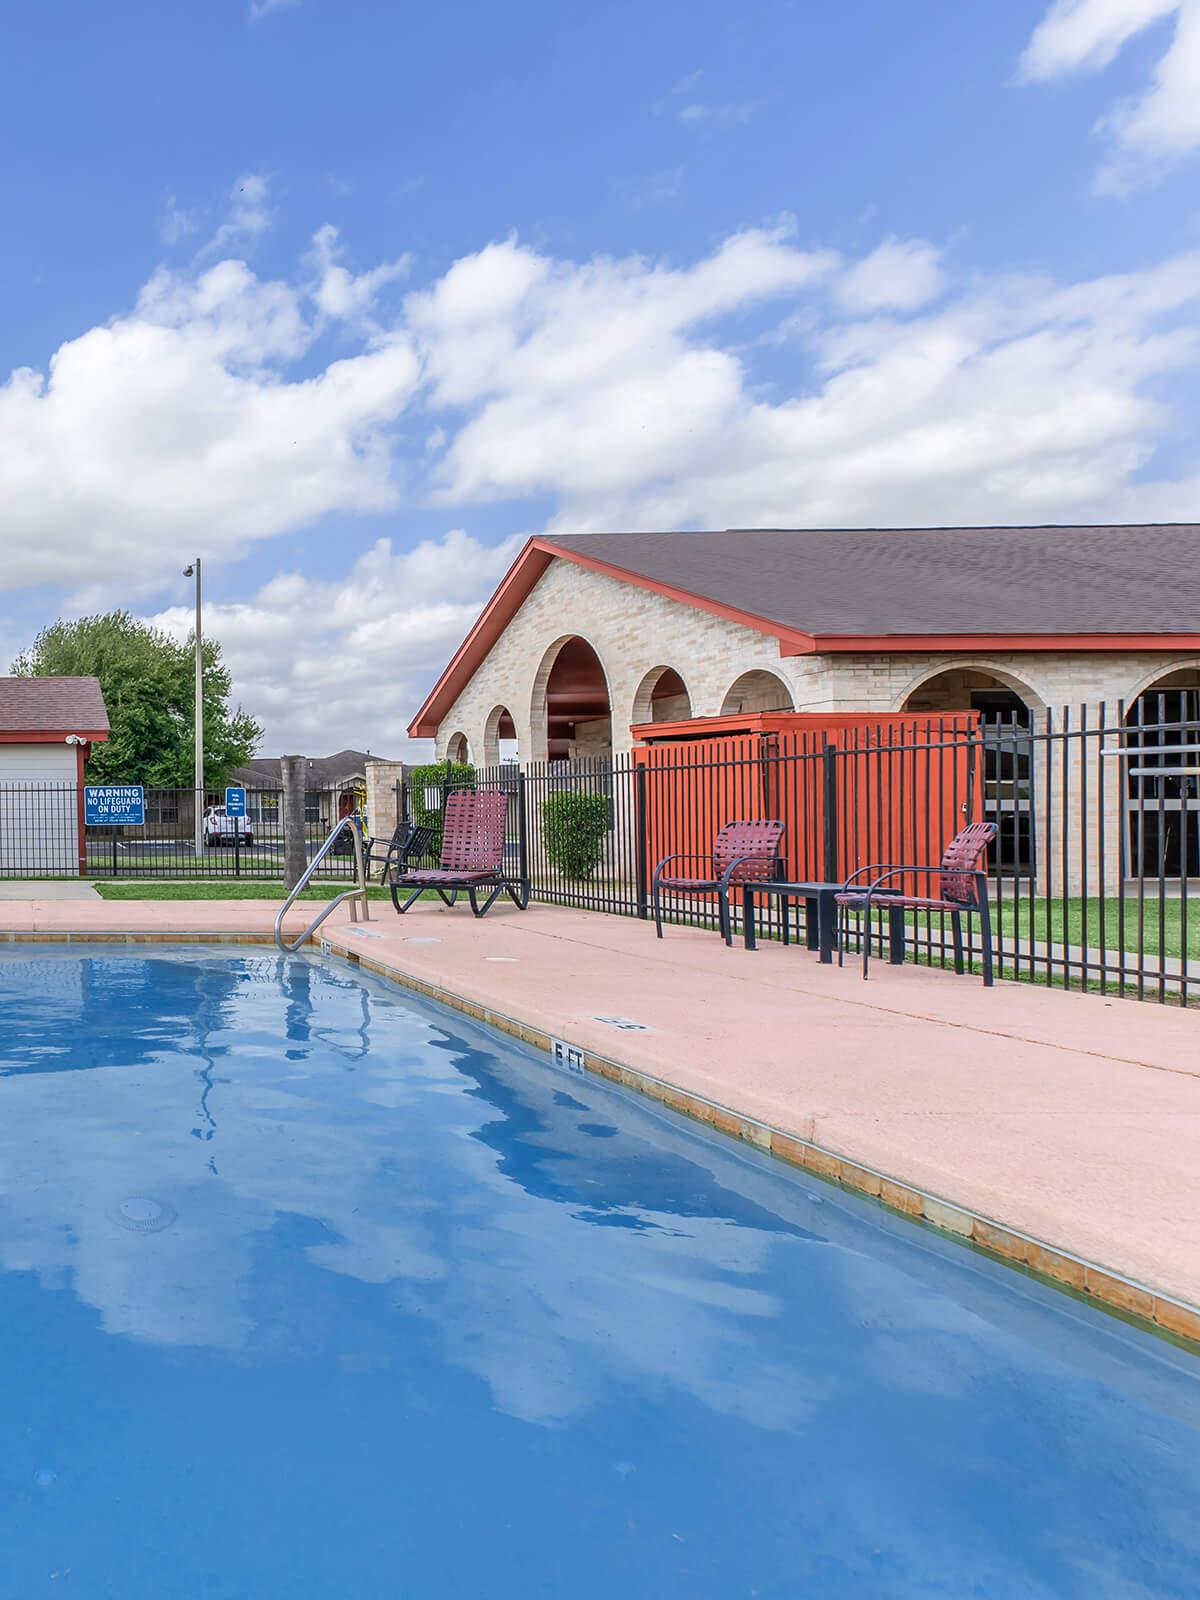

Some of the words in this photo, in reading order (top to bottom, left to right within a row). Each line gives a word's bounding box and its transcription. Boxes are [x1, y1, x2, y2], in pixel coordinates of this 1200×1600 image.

[89, 788, 139, 797] WARNING
[87, 797, 98, 805] NO
[99, 797, 141, 805] LIFEGUARD
[98, 805, 109, 813] ON
[111, 805, 130, 813] DUTY
[567, 1047, 582, 1066] FT
